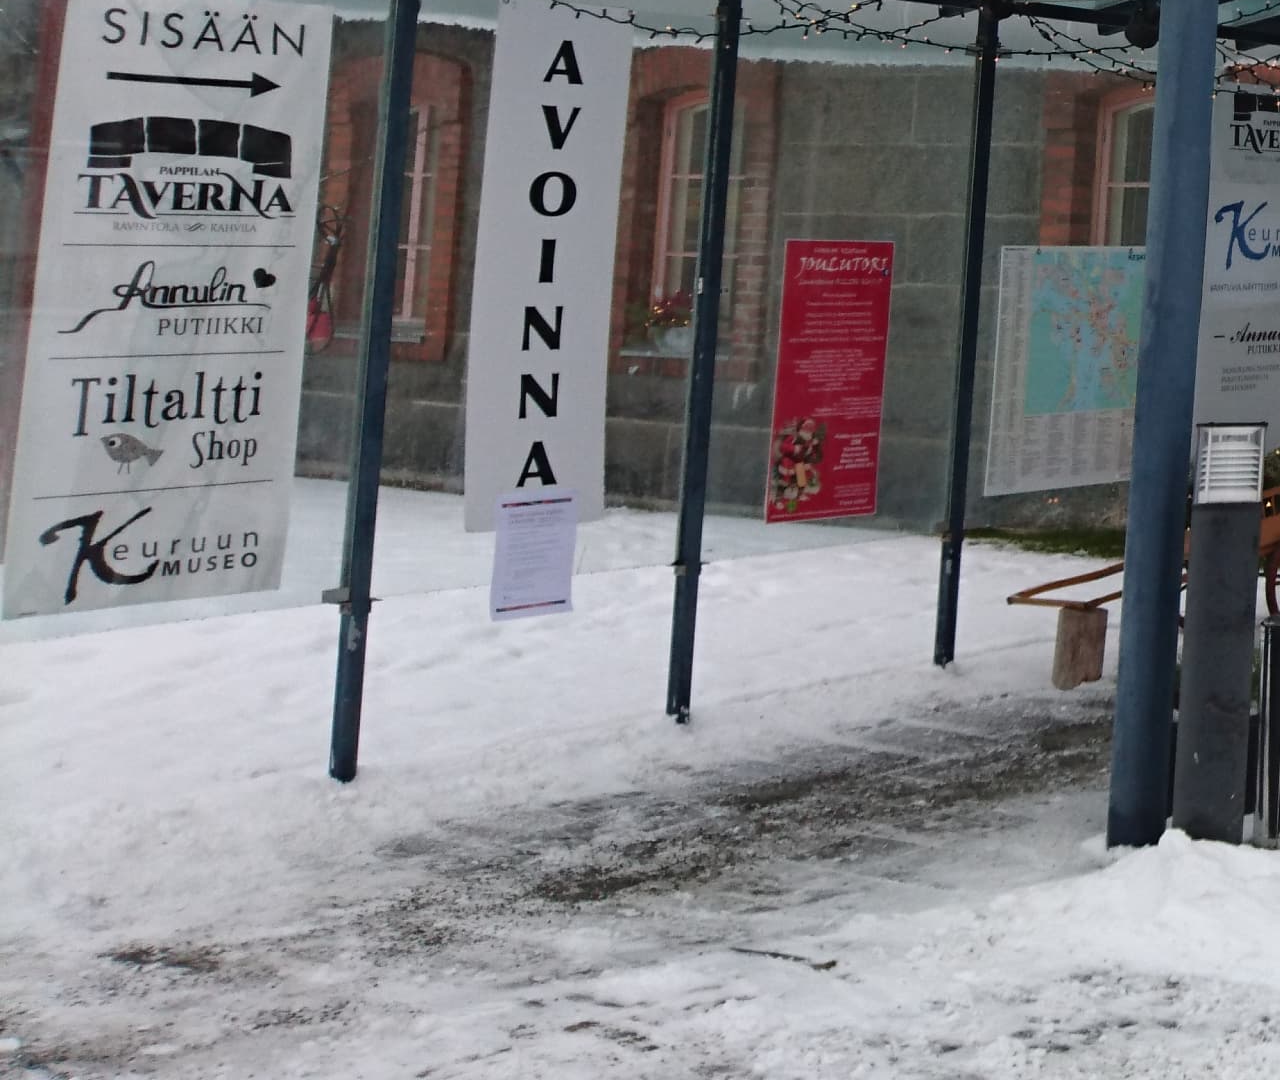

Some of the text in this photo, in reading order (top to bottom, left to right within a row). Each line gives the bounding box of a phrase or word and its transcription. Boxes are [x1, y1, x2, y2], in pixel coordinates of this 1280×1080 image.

[102, 8, 305, 56] SISÄÄN
[159, 166, 220, 177] PAPPILAN
[78, 172, 292, 219] TAVERNA
[113, 222, 256, 233] RAVINTOLA KAHVILA
[515, 39, 584, 488] AVOINNA
[793, 256, 889, 280] JOULUTORI
[98, 260, 260, 312] Annulin
[157, 317, 264, 336] PUTIIKKI
[72, 371, 263, 437] Tiltaltti
[189, 430, 258, 469] Shop
[39, 506, 259, 606] Keuruun
[161, 551, 258, 577] MUSEO
